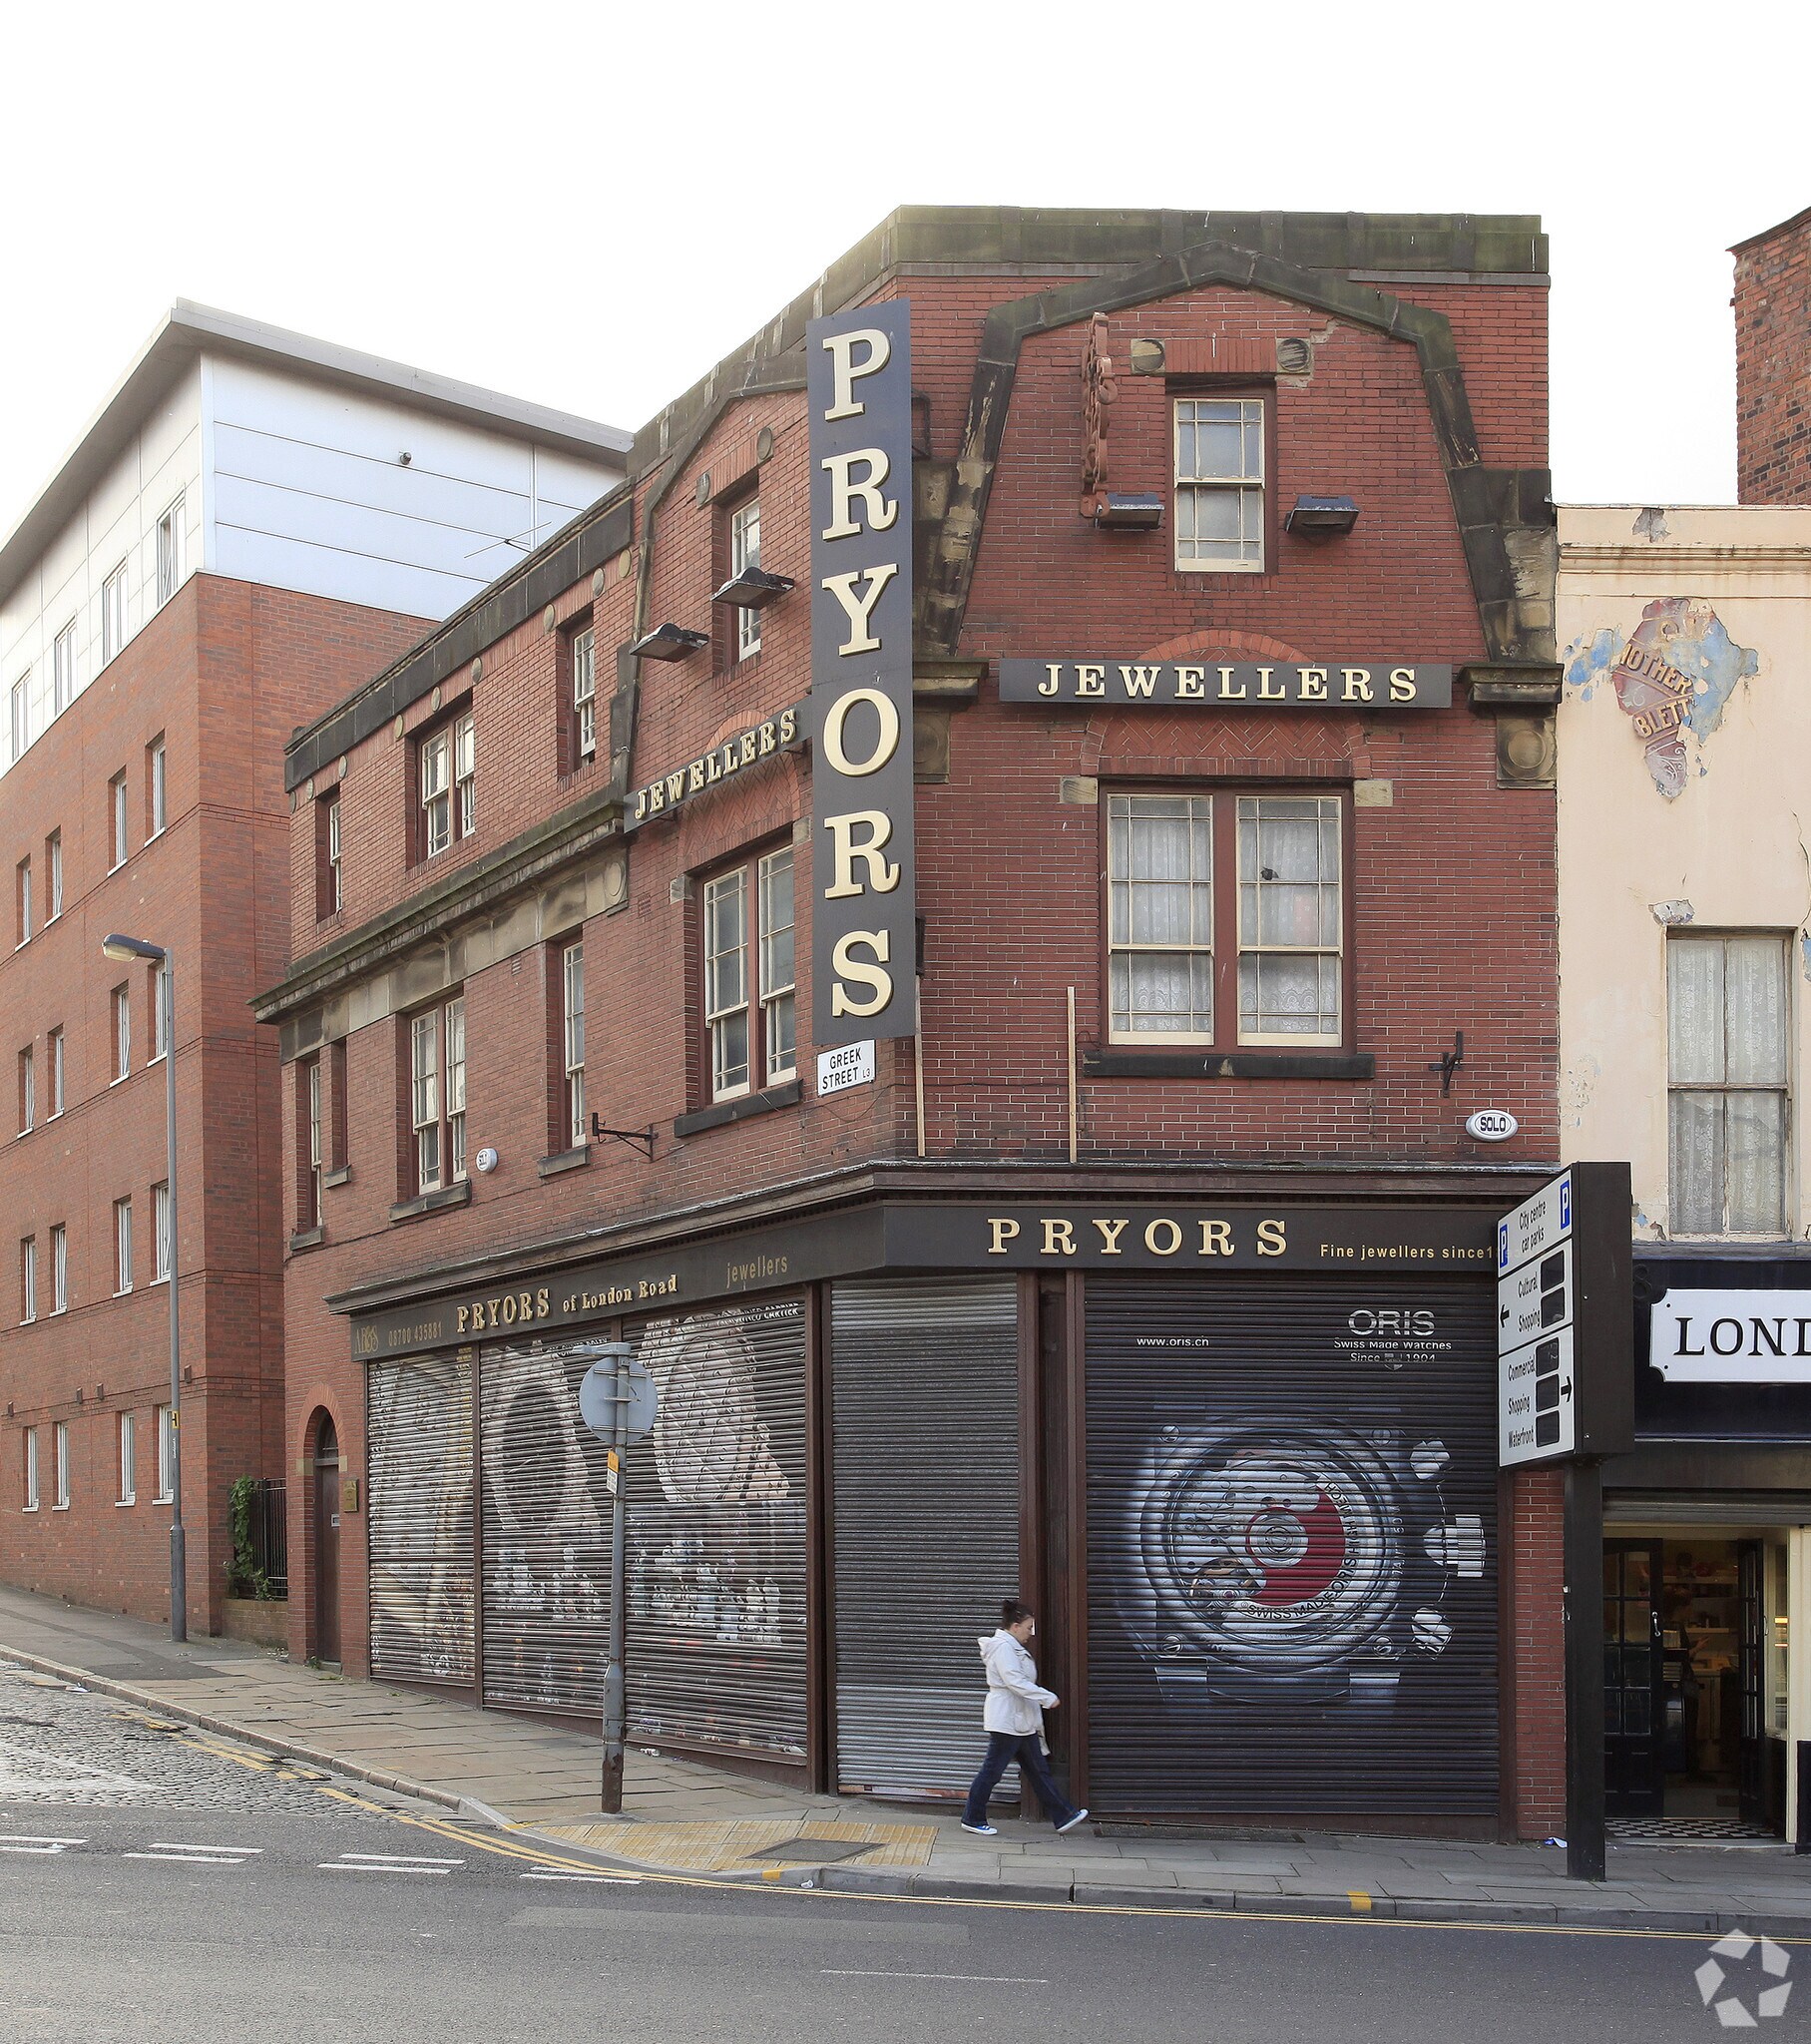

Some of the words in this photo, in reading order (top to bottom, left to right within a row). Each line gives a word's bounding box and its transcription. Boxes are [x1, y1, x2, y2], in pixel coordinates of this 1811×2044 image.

[820, 327, 900, 1018] PRYORS
[1037, 665, 1418, 702] JEWELLERS
[635, 709, 797, 820] JEWELLERS
[830, 1047, 861, 1069] GREEK
[822, 1067, 858, 1089] STREET
[1481, 1117, 1506, 1132] SOLO
[1519, 1212, 1529, 1230] City
[1530, 1201, 1546, 1223] centre
[987, 1219, 1287, 1257] PRYORS
[1531, 1226, 1545, 1251] parks
[1320, 1245, 1354, 1258] Fine
[1361, 1246, 1435, 1261] jewellers
[726, 1256, 787, 1288] jewellers
[1519, 1272, 1538, 1297] Cultural
[457, 1287, 550, 1333] PRYORS
[563, 1294, 578, 1312] of
[582, 1286, 633, 1309] London
[639, 1275, 678, 1298] Road
[1348, 1309, 1435, 1335] ORIS
[1519, 1308, 1540, 1332] Shopping
[1136, 1335, 1208, 1346] www.oris.cn
[1334, 1337, 1365, 1349] Swiss
[1369, 1339, 1399, 1349] Made
[1403, 1339, 1452, 1349] Watches
[1351, 1353, 1380, 1362] Since
[1406, 1353, 1435, 1362] 1904
[1509, 1354, 1535, 1381] Commercial
[1509, 1393, 1530, 1415] Shopping
[1509, 1426, 1534, 1447] Waterfront
